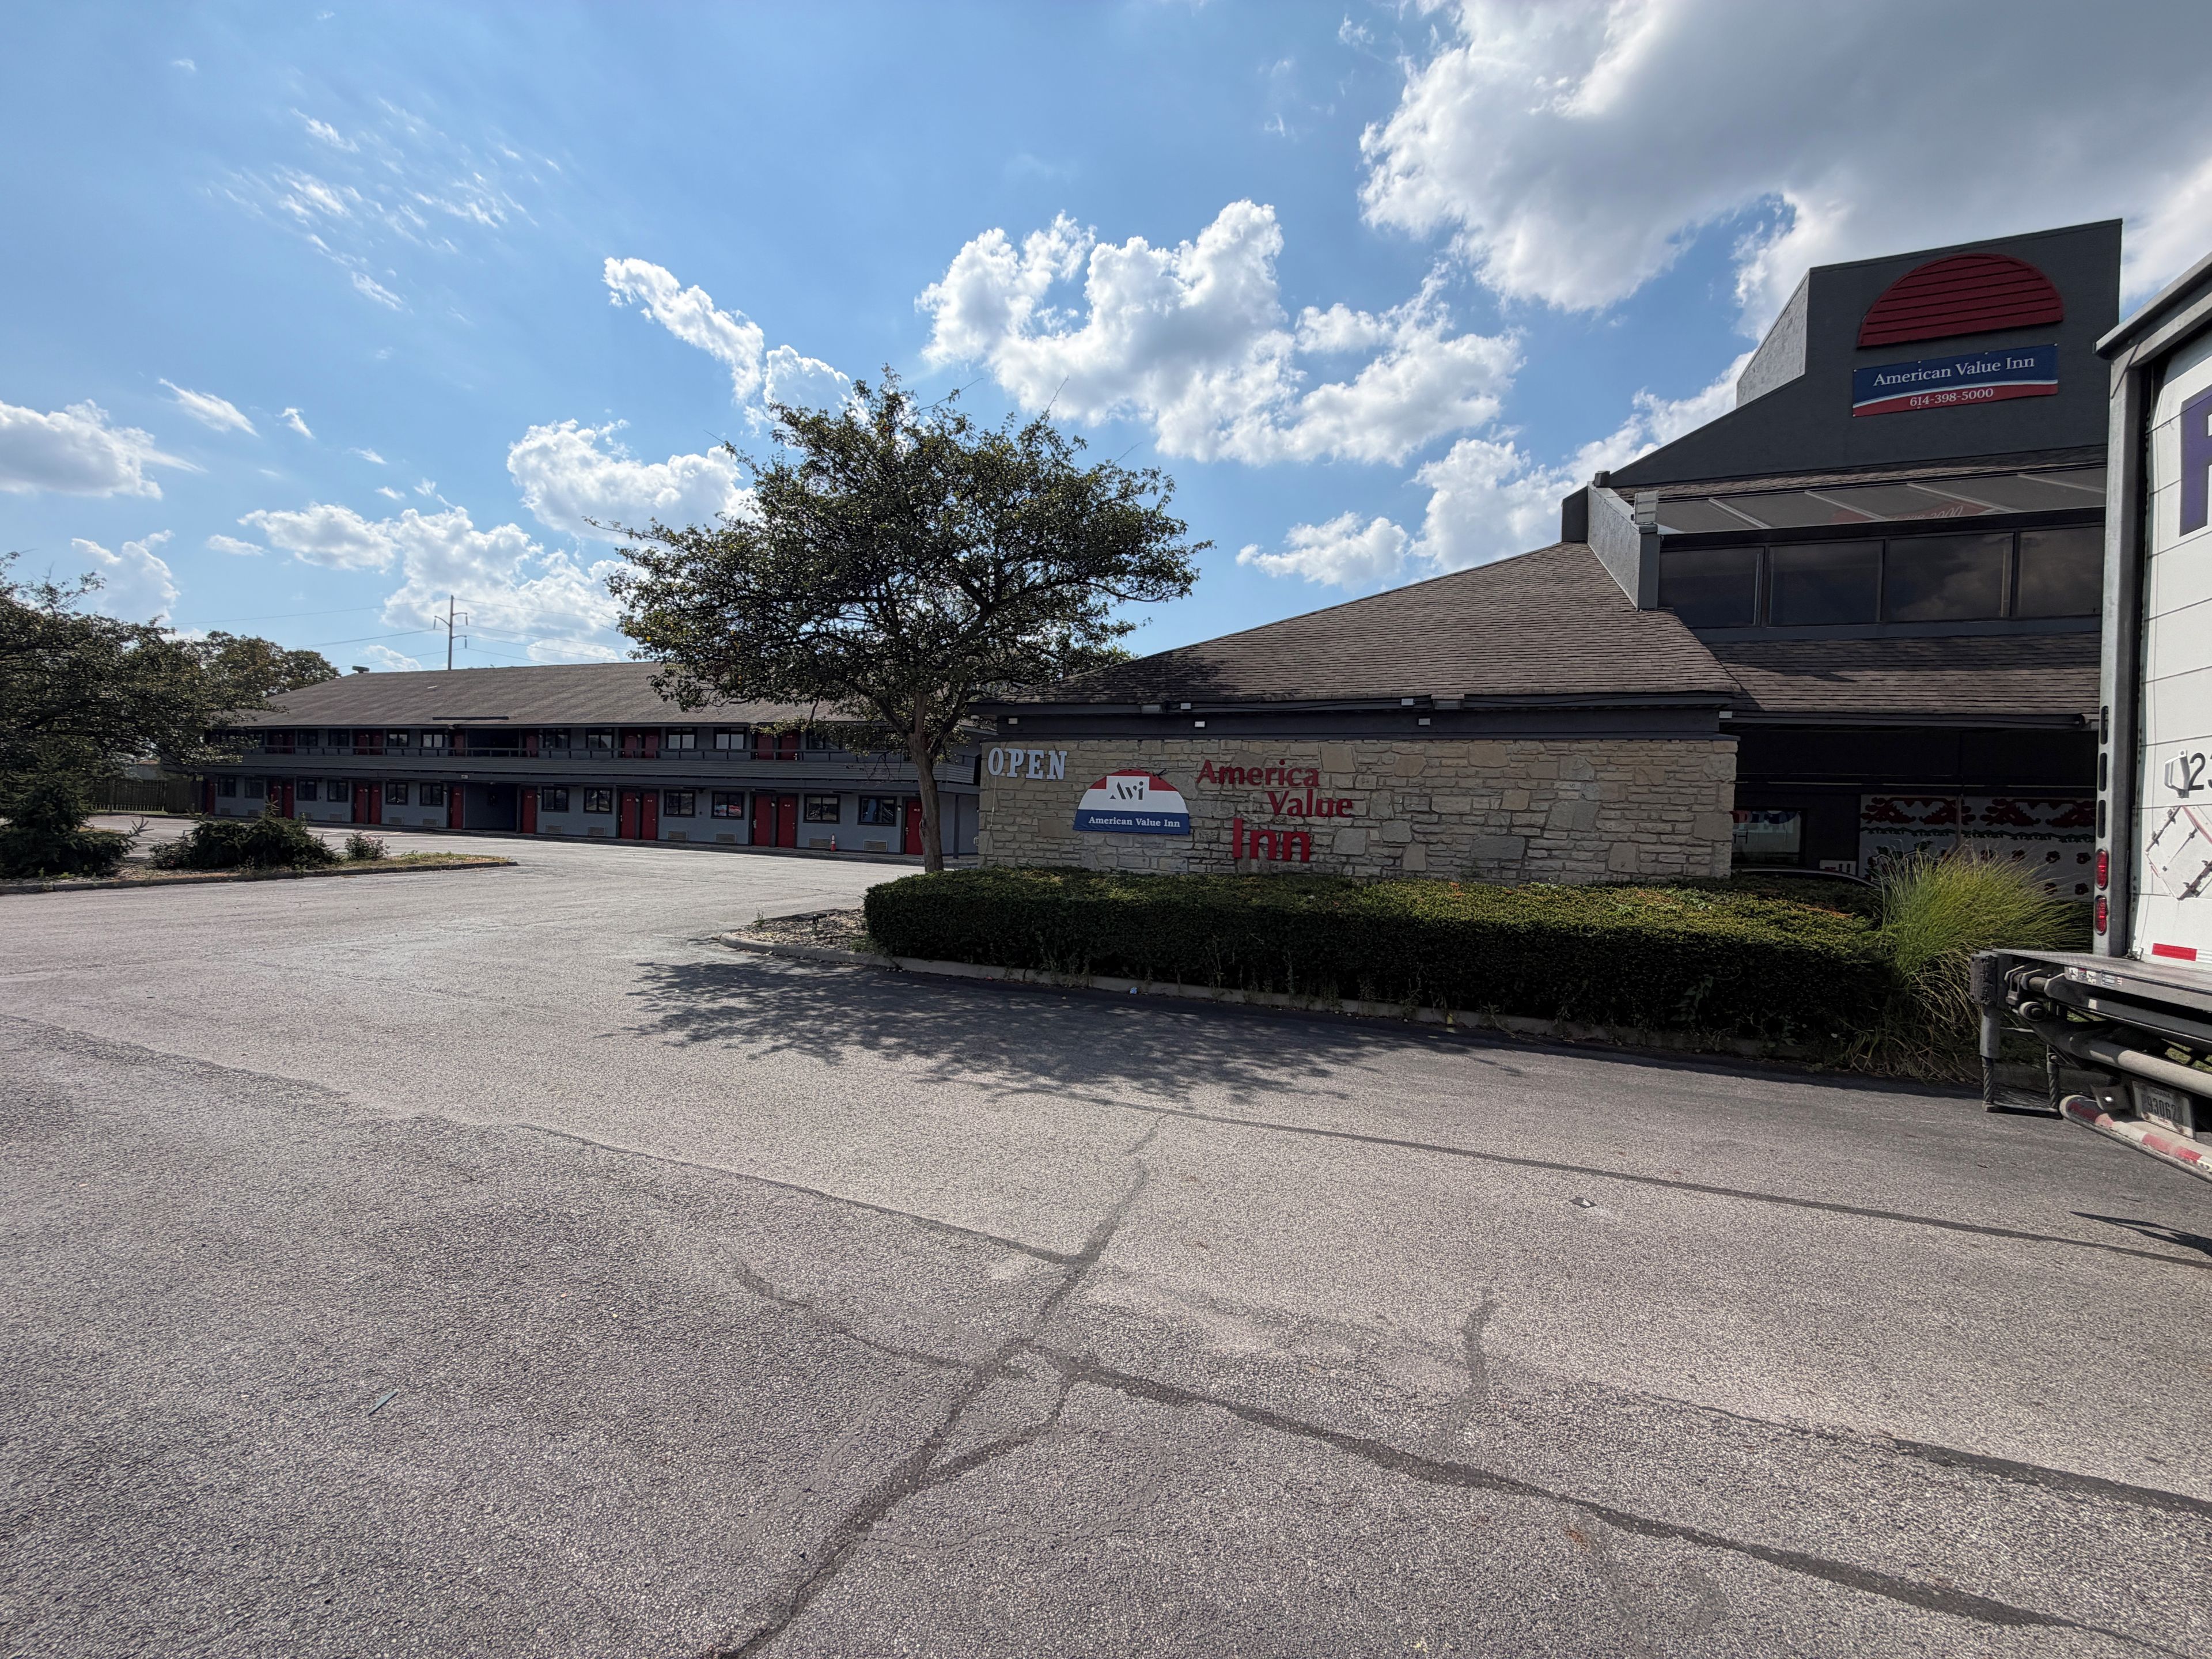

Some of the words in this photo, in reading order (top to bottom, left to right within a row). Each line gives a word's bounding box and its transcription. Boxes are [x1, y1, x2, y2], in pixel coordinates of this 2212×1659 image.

[1873, 369, 1951, 387] American
[1956, 359, 2001, 376] Value
[2006, 356, 2035, 370] Inn
[1910, 388, 1994, 407] 614-398-5000
[987, 747, 1067, 780] OPEN
[1197, 759, 1319, 787] America
[1267, 788, 1354, 817] Value
[1089, 816, 1133, 826] American
[1135, 817, 1161, 827] Value
[1164, 819, 1180, 827] Inn
[1232, 817, 1310, 862] Inn
